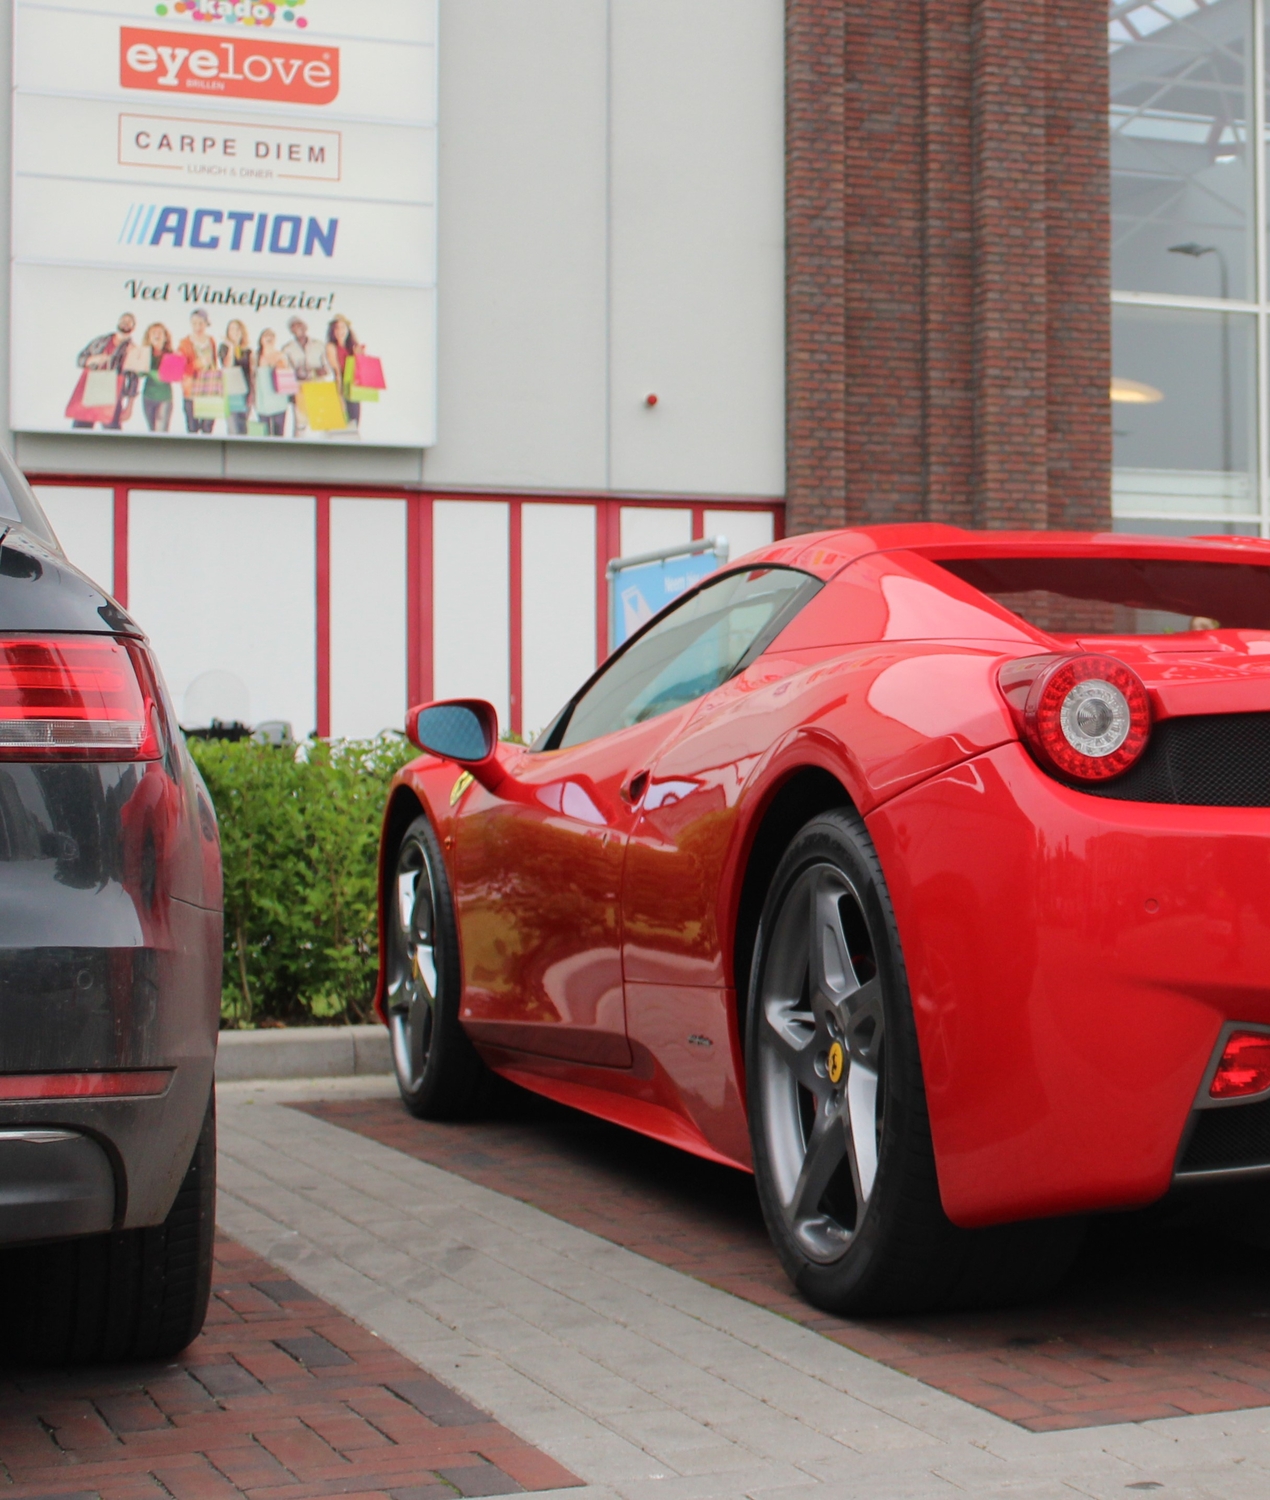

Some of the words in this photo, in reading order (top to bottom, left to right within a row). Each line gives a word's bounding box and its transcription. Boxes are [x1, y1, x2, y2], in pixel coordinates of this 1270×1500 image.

[126, 42, 332, 88] eyelove
[135, 131, 237, 157] CARPE
[255, 141, 327, 163] DIEM
[187, 163, 227, 177] LUNCH
[239, 167, 274, 179] DINER
[150, 205, 339, 257] ACTION
[124, 279, 170, 301] Veel
[177, 282, 335, 312] Winkelplezier!
